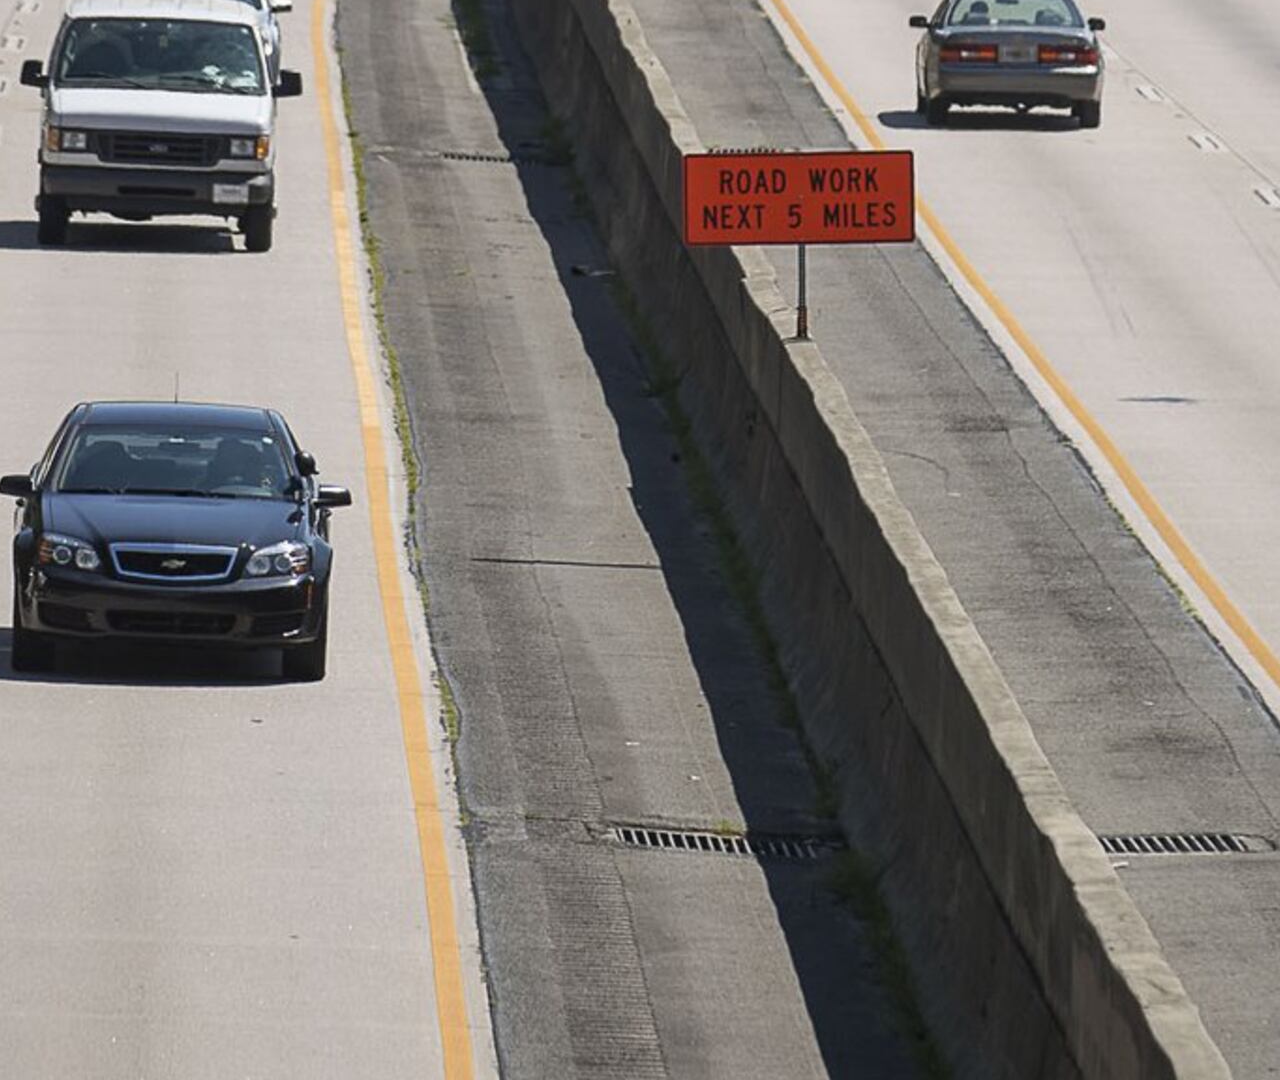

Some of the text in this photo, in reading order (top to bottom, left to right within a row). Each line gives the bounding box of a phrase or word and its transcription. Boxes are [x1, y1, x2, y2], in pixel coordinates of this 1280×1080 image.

[720, 168, 879, 194] ROAD WORK
[703, 203, 896, 229] NEXT 5 MILES
